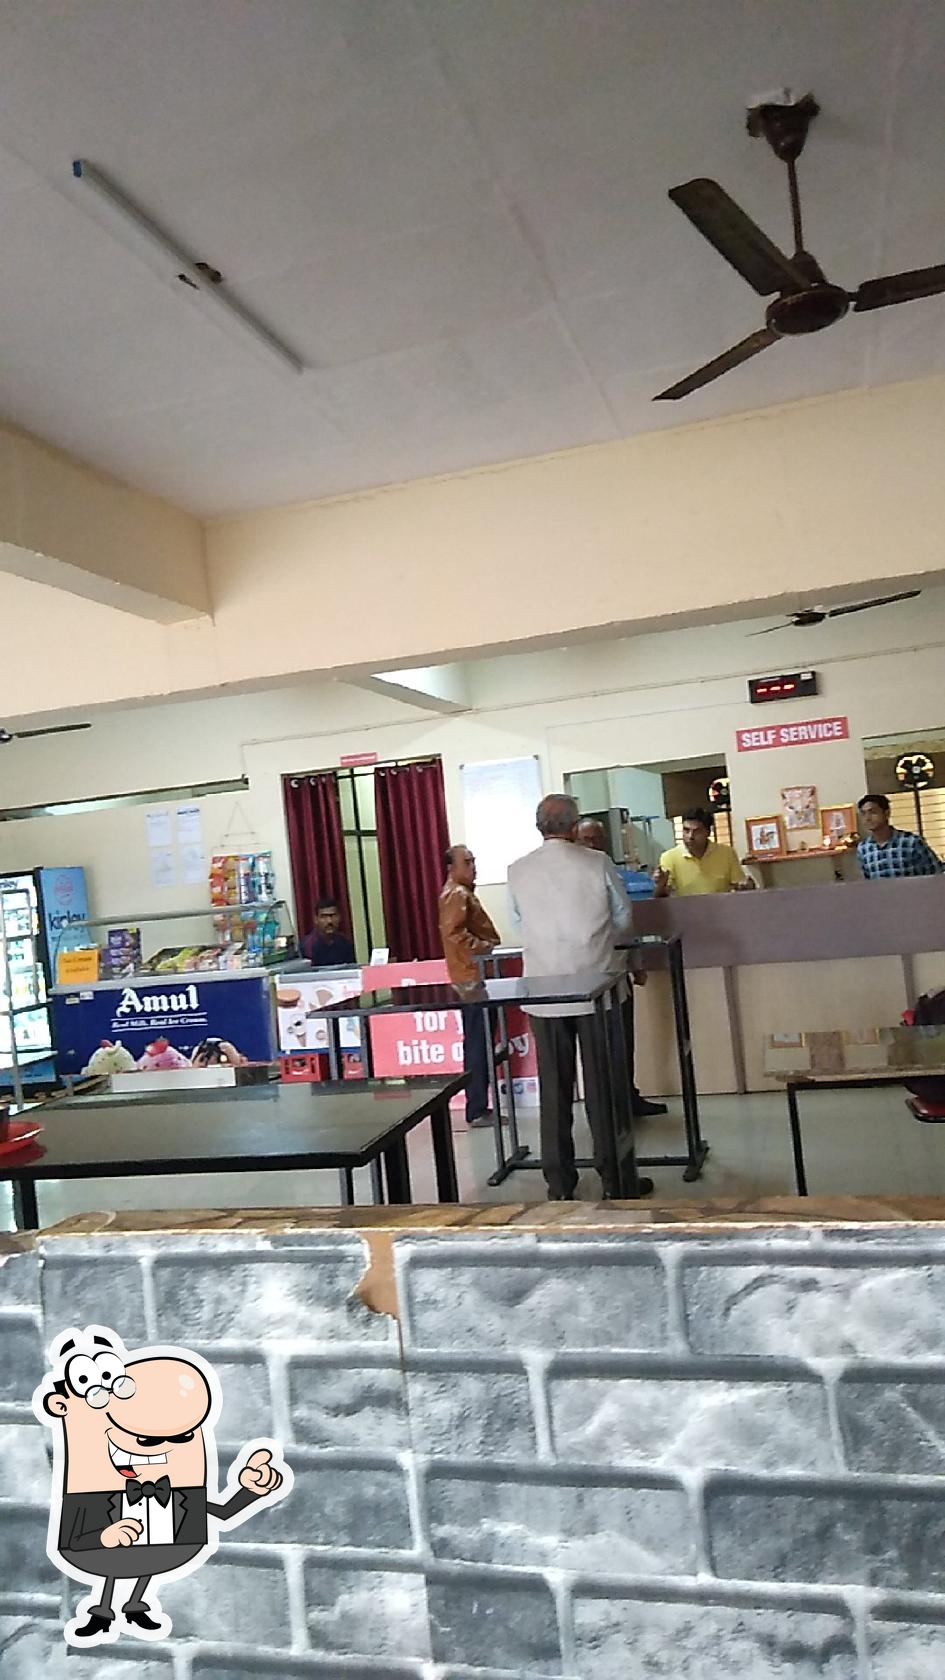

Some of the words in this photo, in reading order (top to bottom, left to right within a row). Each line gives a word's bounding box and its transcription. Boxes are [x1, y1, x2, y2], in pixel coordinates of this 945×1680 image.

[741, 730, 777, 748] SELF
[780, 721, 844, 744] SERVICE
[115, 984, 200, 1018] Amul
[413, 1010, 447, 1033] for
[396, 1039, 446, 1067] bite
